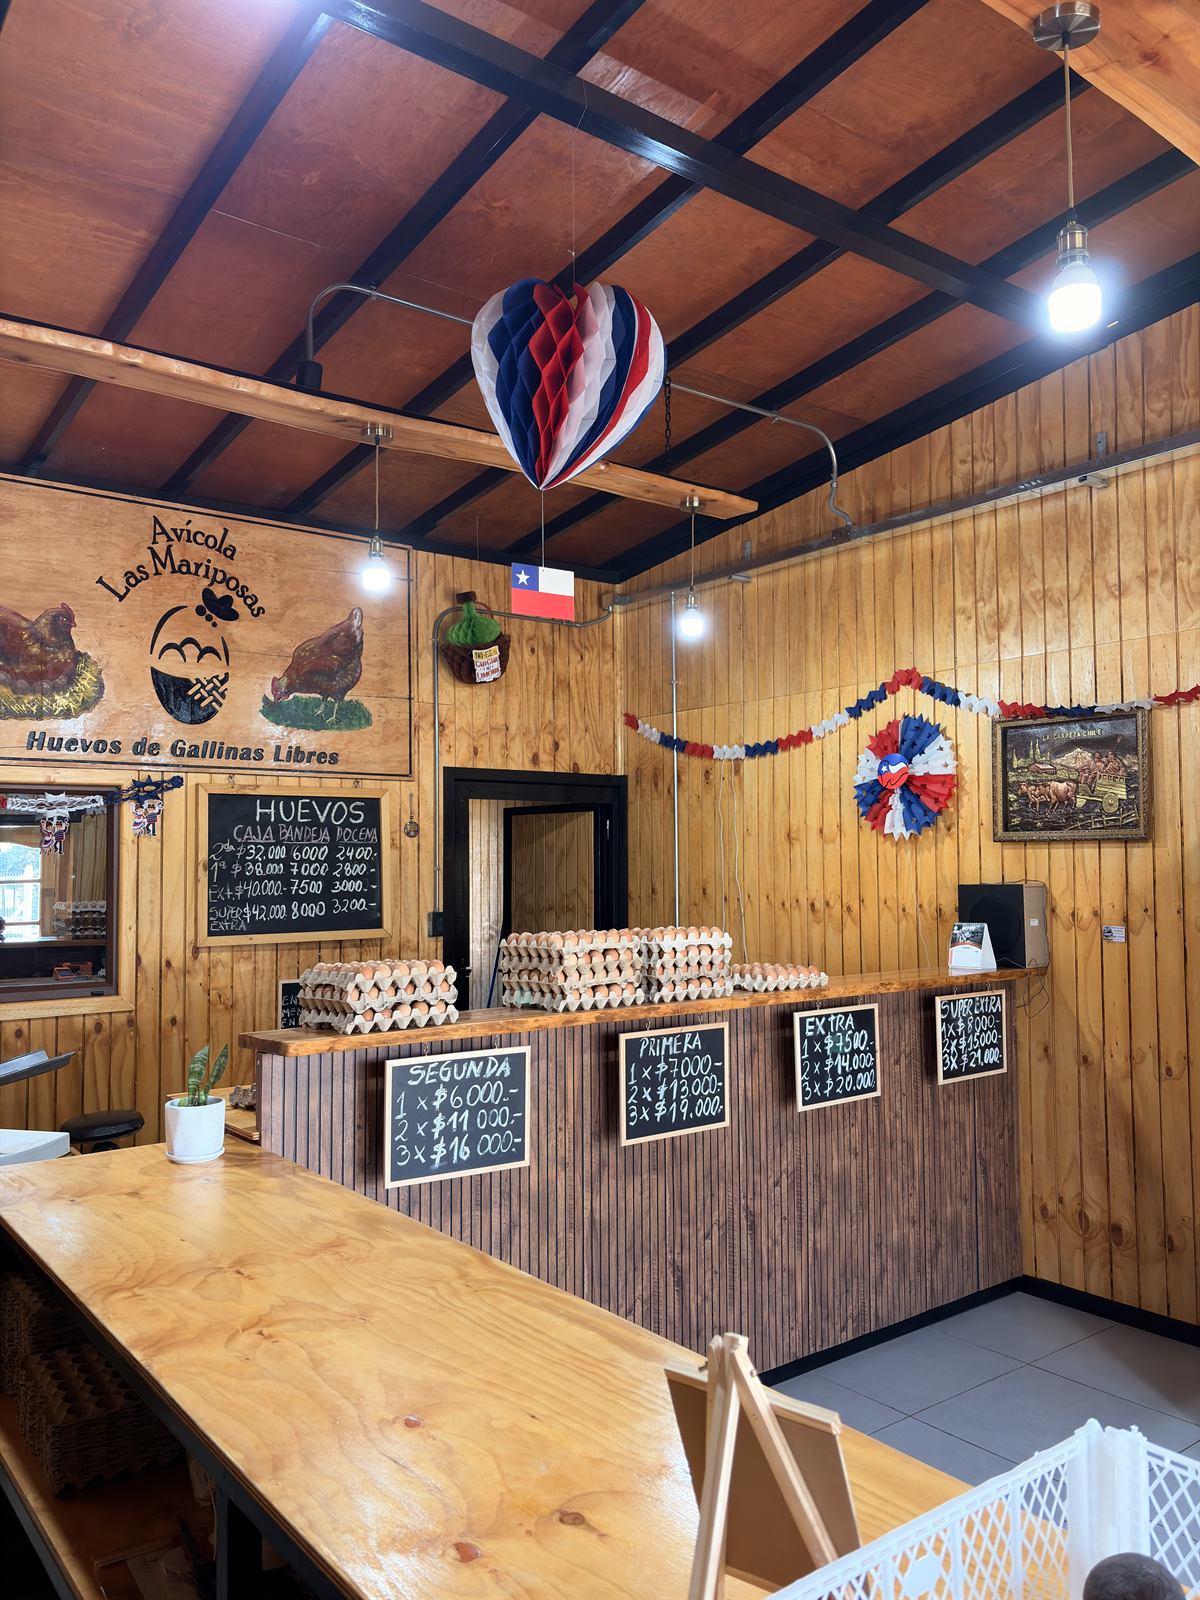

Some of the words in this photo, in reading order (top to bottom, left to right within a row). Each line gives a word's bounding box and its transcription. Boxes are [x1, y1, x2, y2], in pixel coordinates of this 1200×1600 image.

[151, 515, 237, 561] Avícola
[96, 564, 150, 602] Las
[147, 544, 266, 618] Mariposas
[26, 731, 122, 755] Huevos
[132, 737, 161, 756] de
[170, 739, 264, 761] Gallinas
[273, 745, 339, 765] Libres
[255, 799, 365, 825] HUEVOS
[233, 824, 275, 842] CAJA
[278, 823, 331, 843] BANDEJA
[336, 827, 378, 843] DOCENA
[293, 845, 328, 860] 6000
[290, 862, 329, 876] 7000
[290, 879, 322, 895] 7500
[292, 901, 326, 919] 8000
[941, 999, 972, 1019] SUPER
[974, 996, 1001, 1014] EXTRA
[805, 1013, 855, 1036] EXTRA
[640, 1032, 702, 1058] PRIMERA
[801, 1039, 809, 1059] 1
[407, 1057, 512, 1086] SEGUNDA
[628, 1063, 637, 1085] 1
[801, 1061, 810, 1080] 2
[628, 1086, 638, 1104] 2
[802, 1081, 812, 1100] 3
[395, 1091, 407, 1120] 1
[629, 1105, 638, 1126] 3
[395, 1119, 409, 1142] 2
[396, 1145, 411, 1167] 3
